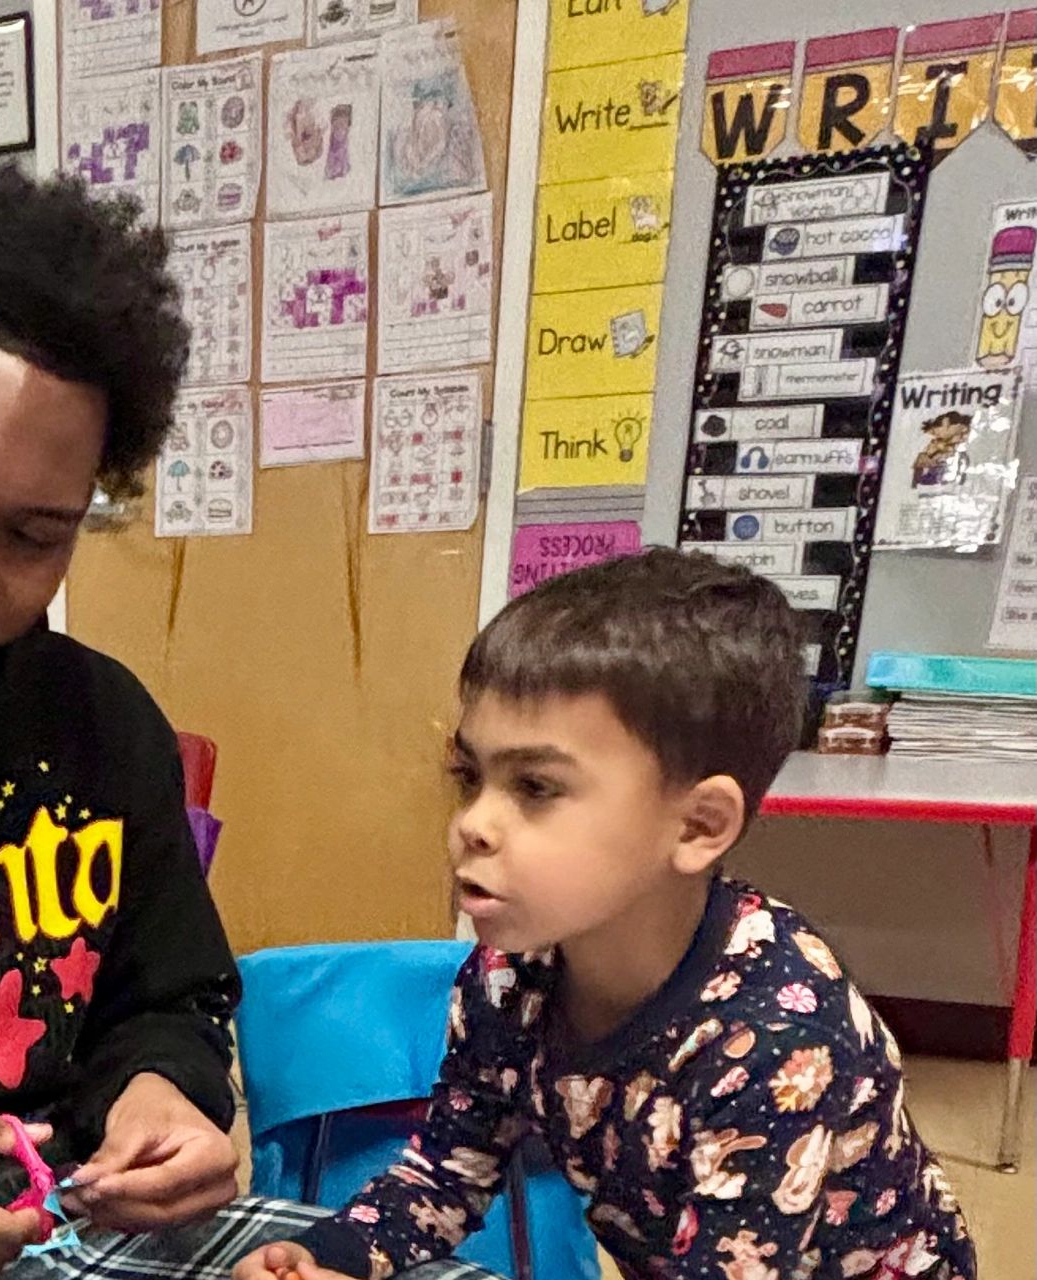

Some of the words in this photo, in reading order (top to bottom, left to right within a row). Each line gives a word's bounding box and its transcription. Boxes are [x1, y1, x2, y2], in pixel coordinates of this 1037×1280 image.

[712, 53, 1037, 159] WRI
[555, 98, 630, 134] Write
[546, 206, 616, 243] Label
[806, 230, 832, 245] hot
[765, 267, 838, 286] snowball
[802, 297, 863, 315] carrot
[538, 328, 607, 356] Draw
[753, 345, 827, 360] snowman
[901, 383, 1002, 408] Writing
[755, 415, 789, 431] coal
[539, 428, 608, 460] Think
[775, 450, 853, 467] earmuffs
[738, 484, 790, 502] shovel
[774, 517, 834, 534] button
[540, 535, 616, 558] PROCESS
